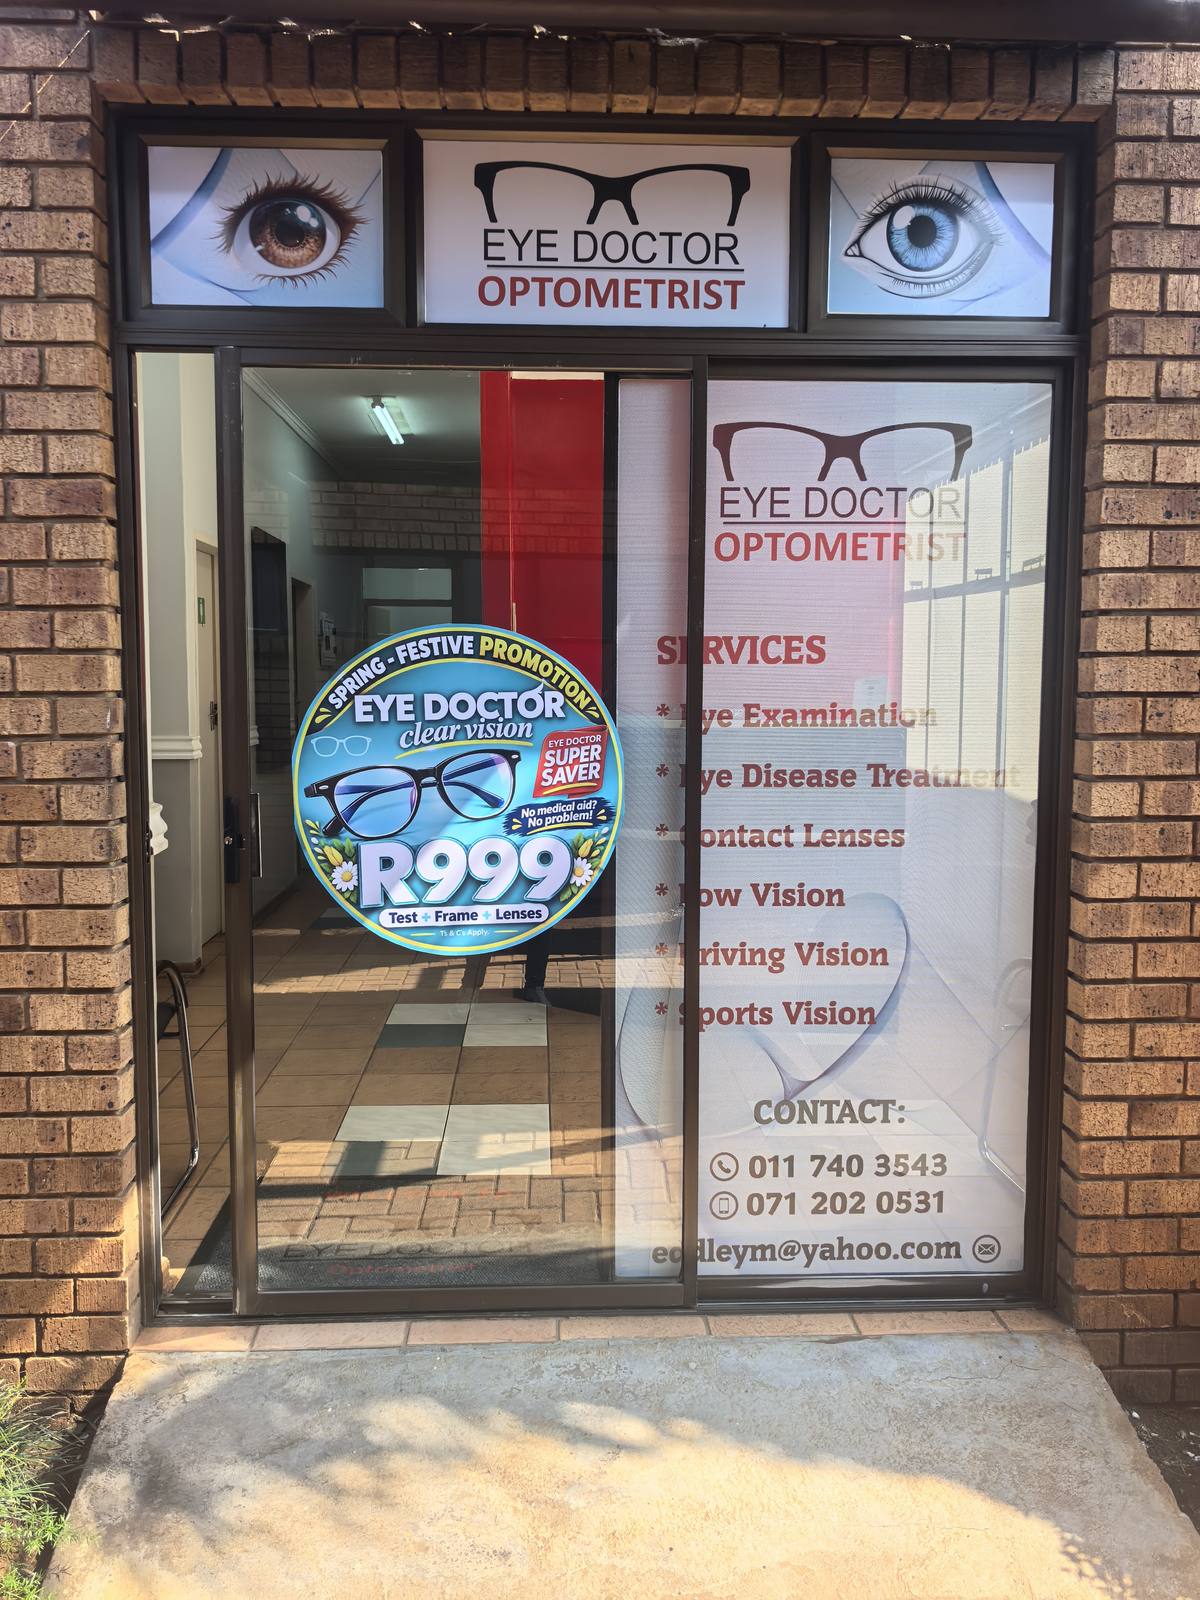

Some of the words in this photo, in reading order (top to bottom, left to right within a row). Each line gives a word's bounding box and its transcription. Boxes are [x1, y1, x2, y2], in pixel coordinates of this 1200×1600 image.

[483, 229, 558, 262] EYE
[574, 230, 740, 265] DOCTOR
[477, 275, 746, 310] OPTOMETRIST
[720, 486, 791, 518] EYE
[804, 486, 962, 519] DOCTOR
[713, 531, 967, 562] OPTOMETRIST
[328, 656, 387, 710] SPRING
[395, 635, 474, 665] FESTIVE
[480, 635, 592, 710] PROMOTION
[354, 693, 416, 722] EYE
[423, 679, 566, 721] DOCTOR
[742, 701, 938, 728] Examination
[399, 721, 461, 749] clear
[464, 716, 533, 740] vision
[548, 739, 563, 748] EYE
[566, 734, 602, 746] DOCTOR
[543, 744, 602, 768] SUPER
[540, 761, 601, 787] SAVER
[741, 763, 857, 788] Disease
[867, 763, 1021, 788] Treatment
[521, 808, 536, 819] No
[537, 801, 575, 816] medical
[577, 800, 597, 810] aid?
[528, 817, 543, 828] No
[544, 810, 593, 828] problem!
[803, 823, 906, 849] Lenses
[358, 834, 575, 908] R999
[750, 882, 846, 908] Vision
[389, 911, 418, 924] Test
[435, 909, 479, 923] Frame
[496, 907, 542, 921] Lenses
[449, 929, 455, 937] &
[794, 941, 889, 967] Vision
[782, 1000, 877, 1026] Vision
[753, 1099, 906, 1125] CONTACT:
[748, 1154, 795, 1178] 011
[810, 1153, 864, 1178] 740
[873, 1153, 948, 1178] 3543
[747, 1191, 797, 1216] 071
[810, 1190, 866, 1216] 202
[876, 1190, 945, 1215] 0531
